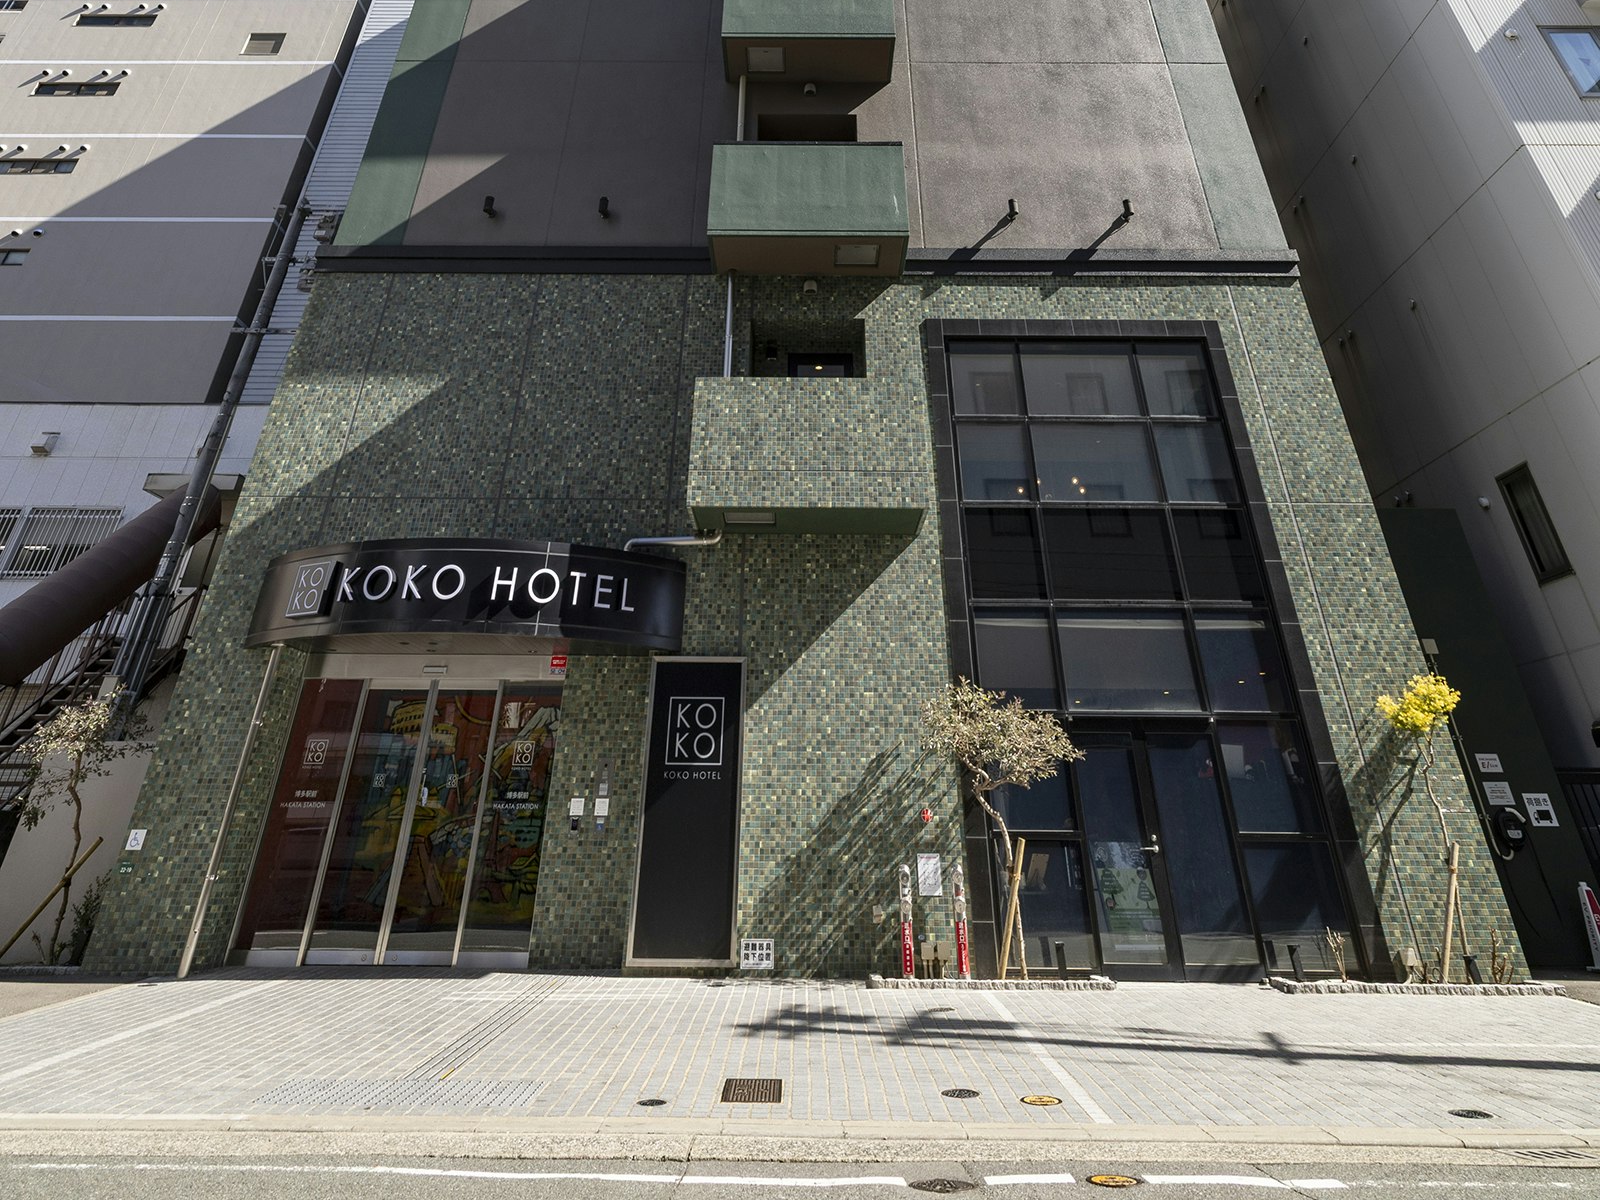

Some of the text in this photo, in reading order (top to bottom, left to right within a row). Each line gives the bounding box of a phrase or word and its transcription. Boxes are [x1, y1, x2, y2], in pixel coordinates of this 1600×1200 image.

[298, 567, 324, 588] KO
[337, 564, 635, 612] KOKO HOTEL
[291, 589, 318, 610] KO
[676, 703, 717, 729] KO
[309, 741, 326, 752] KO
[517, 742, 533, 753] KO
[674, 732, 715, 759] KO
[306, 752, 323, 762] KO
[515, 753, 531, 763] KO
[663, 770, 722, 780] KOKO HOTEL
[743, 942, 772, 951] 避難器具
[743, 952, 772, 961] 降下位置
